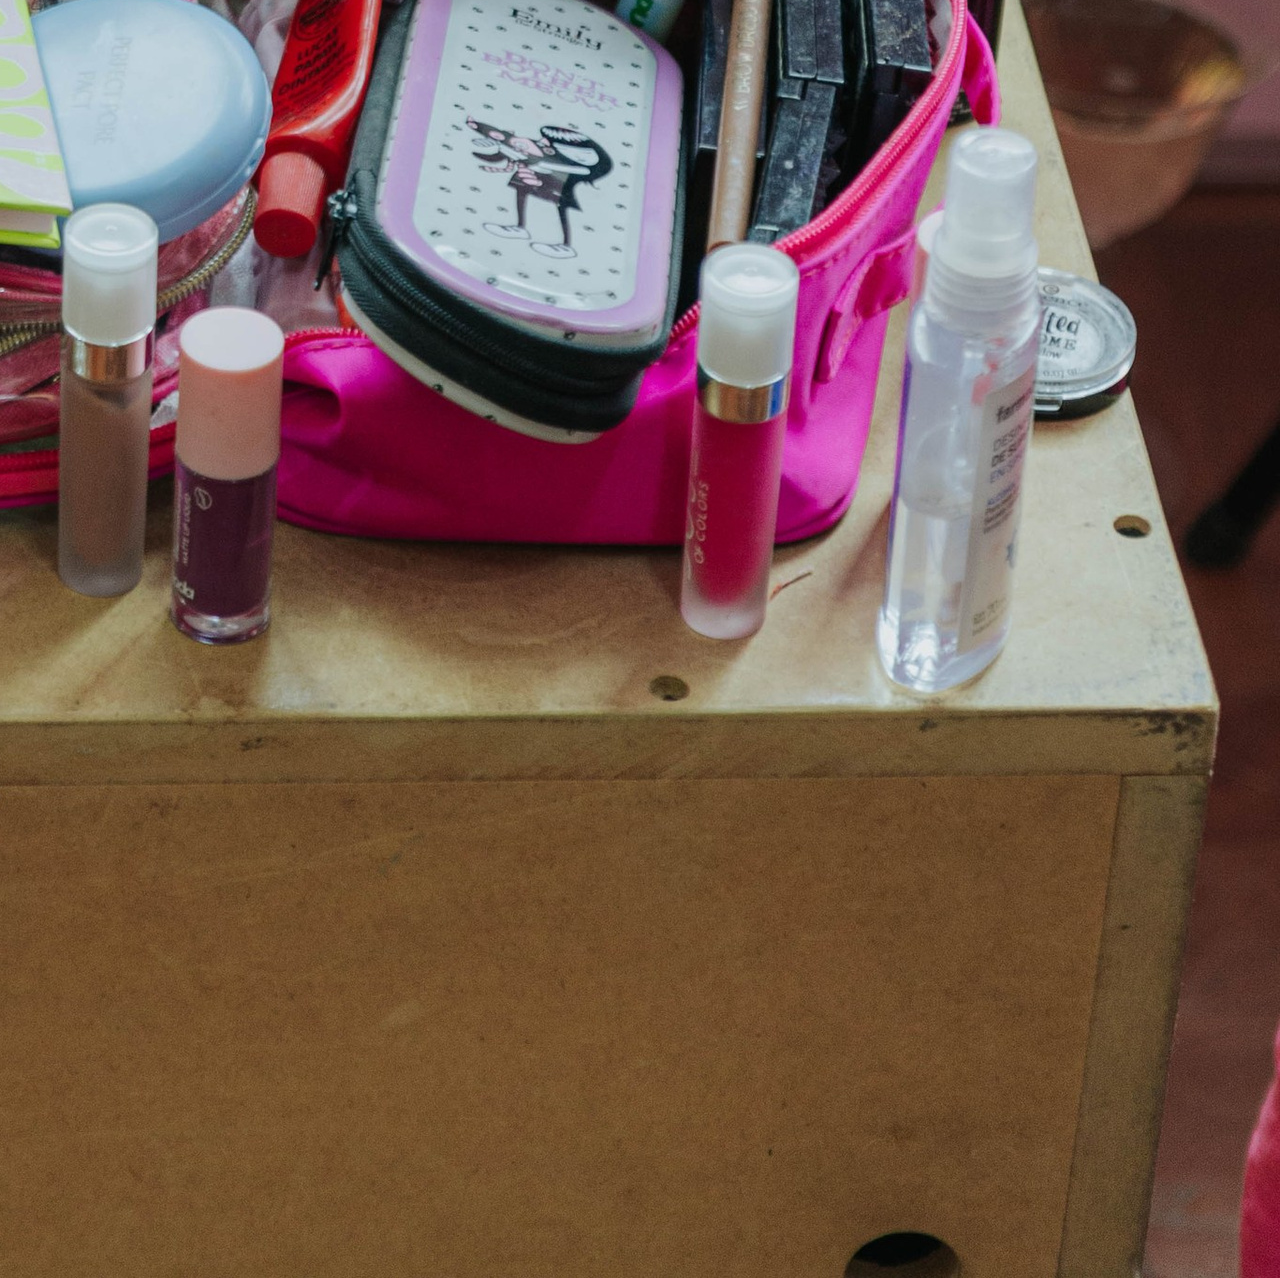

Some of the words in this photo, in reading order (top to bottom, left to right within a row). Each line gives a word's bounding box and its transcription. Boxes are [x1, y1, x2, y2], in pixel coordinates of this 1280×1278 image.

[510, 7, 601, 50] Emily
[483, 52, 621, 107] BOTHER
[696, 480, 710, 541] COLORS
